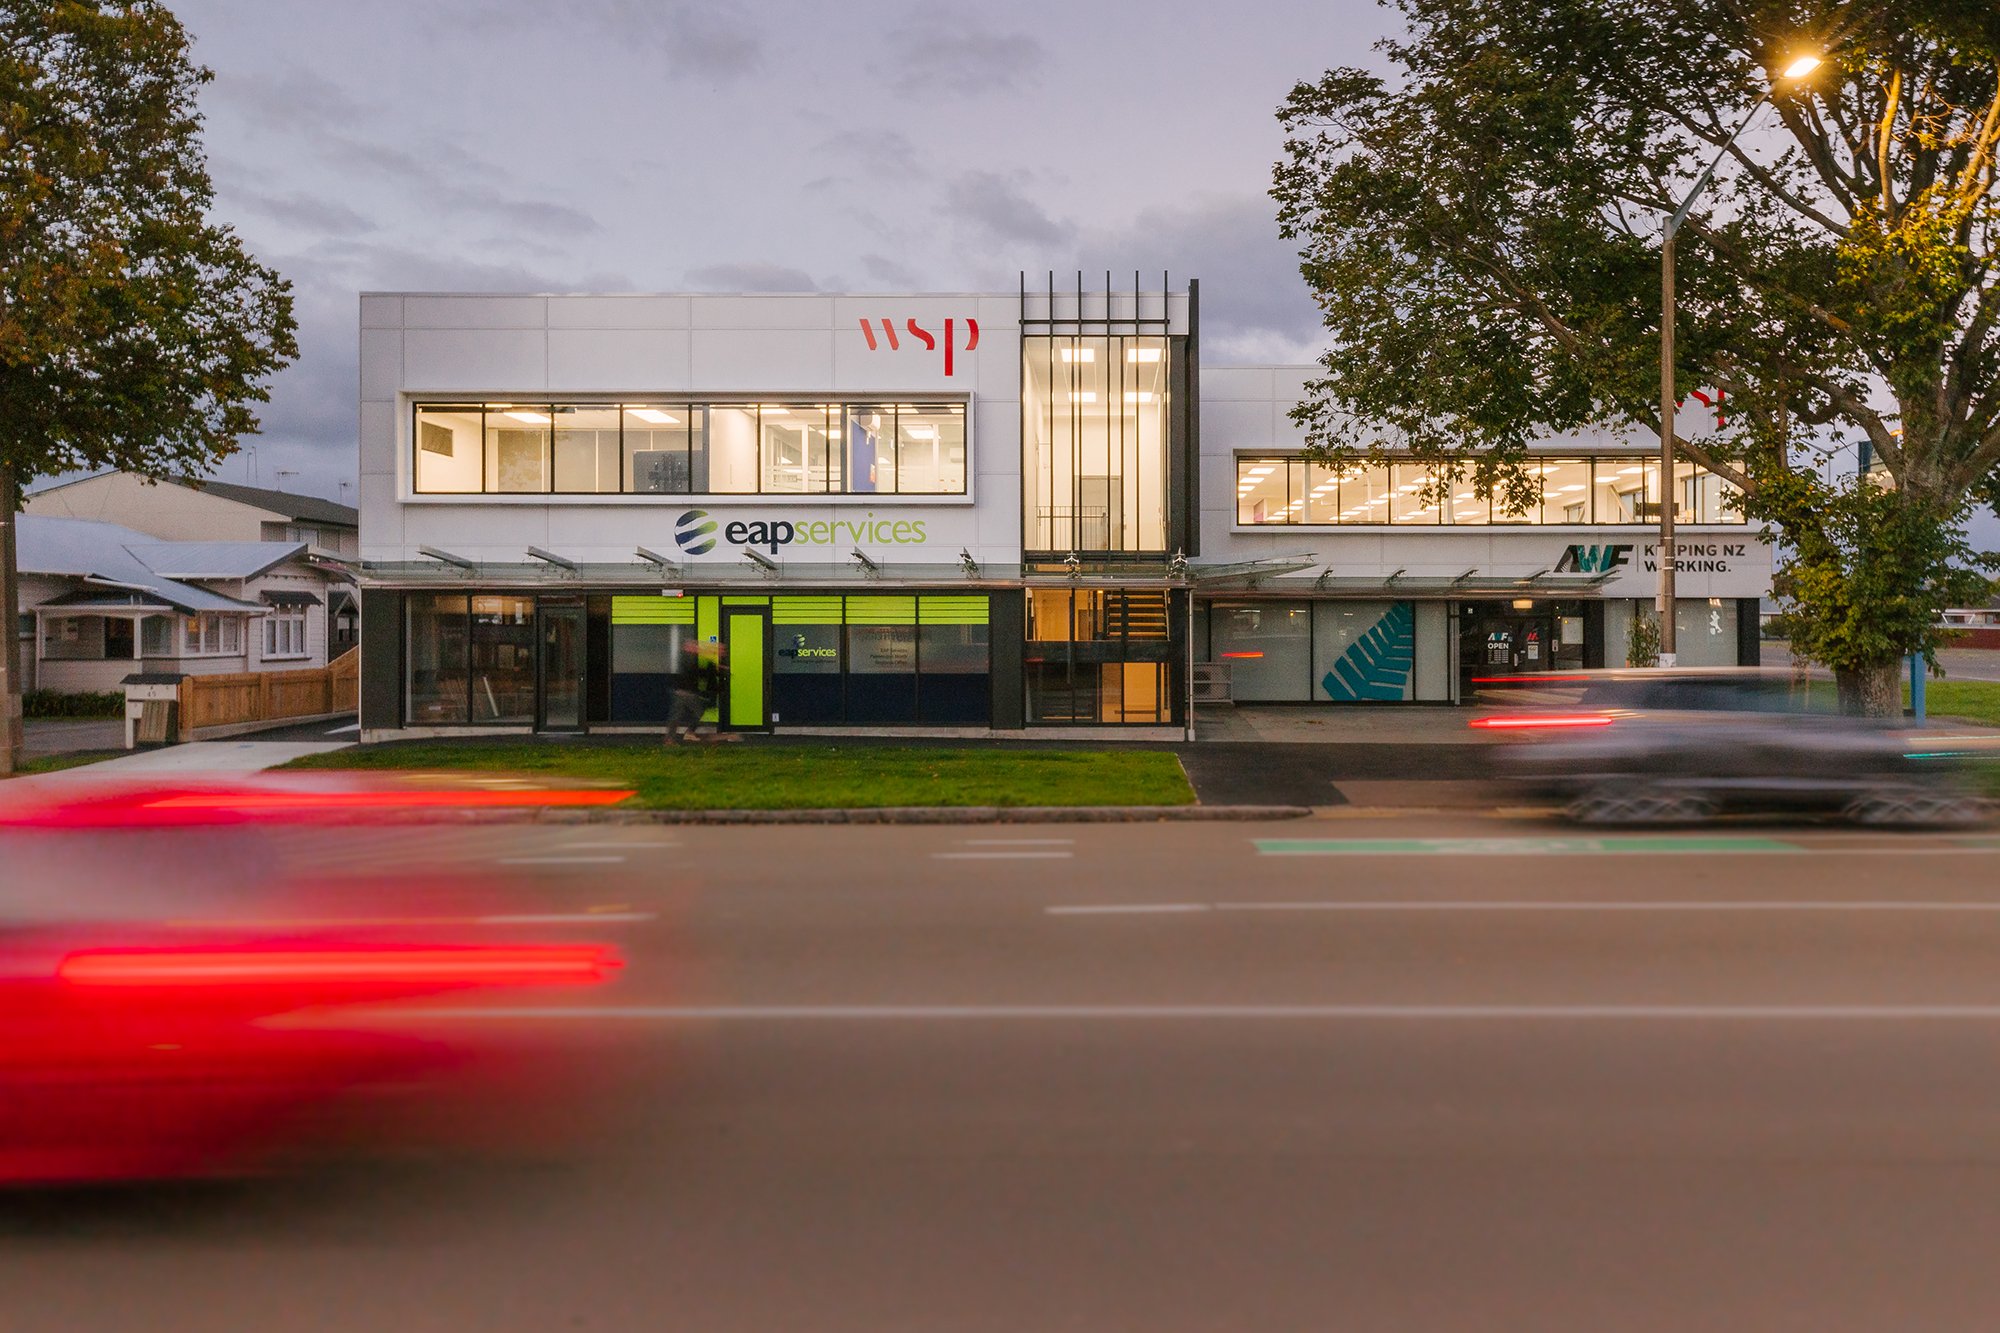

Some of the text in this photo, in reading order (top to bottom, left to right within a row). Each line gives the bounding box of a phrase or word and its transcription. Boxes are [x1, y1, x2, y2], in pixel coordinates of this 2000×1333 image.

[859, 318, 979, 376] wsp
[725, 512, 927, 555] eapservices
[1553, 545, 1634, 573] AWF
[1644, 544, 1746, 557] KPING NZ
[1644, 560, 1732, 573] WRKING.
[1487, 642, 1509, 650] OPEN
